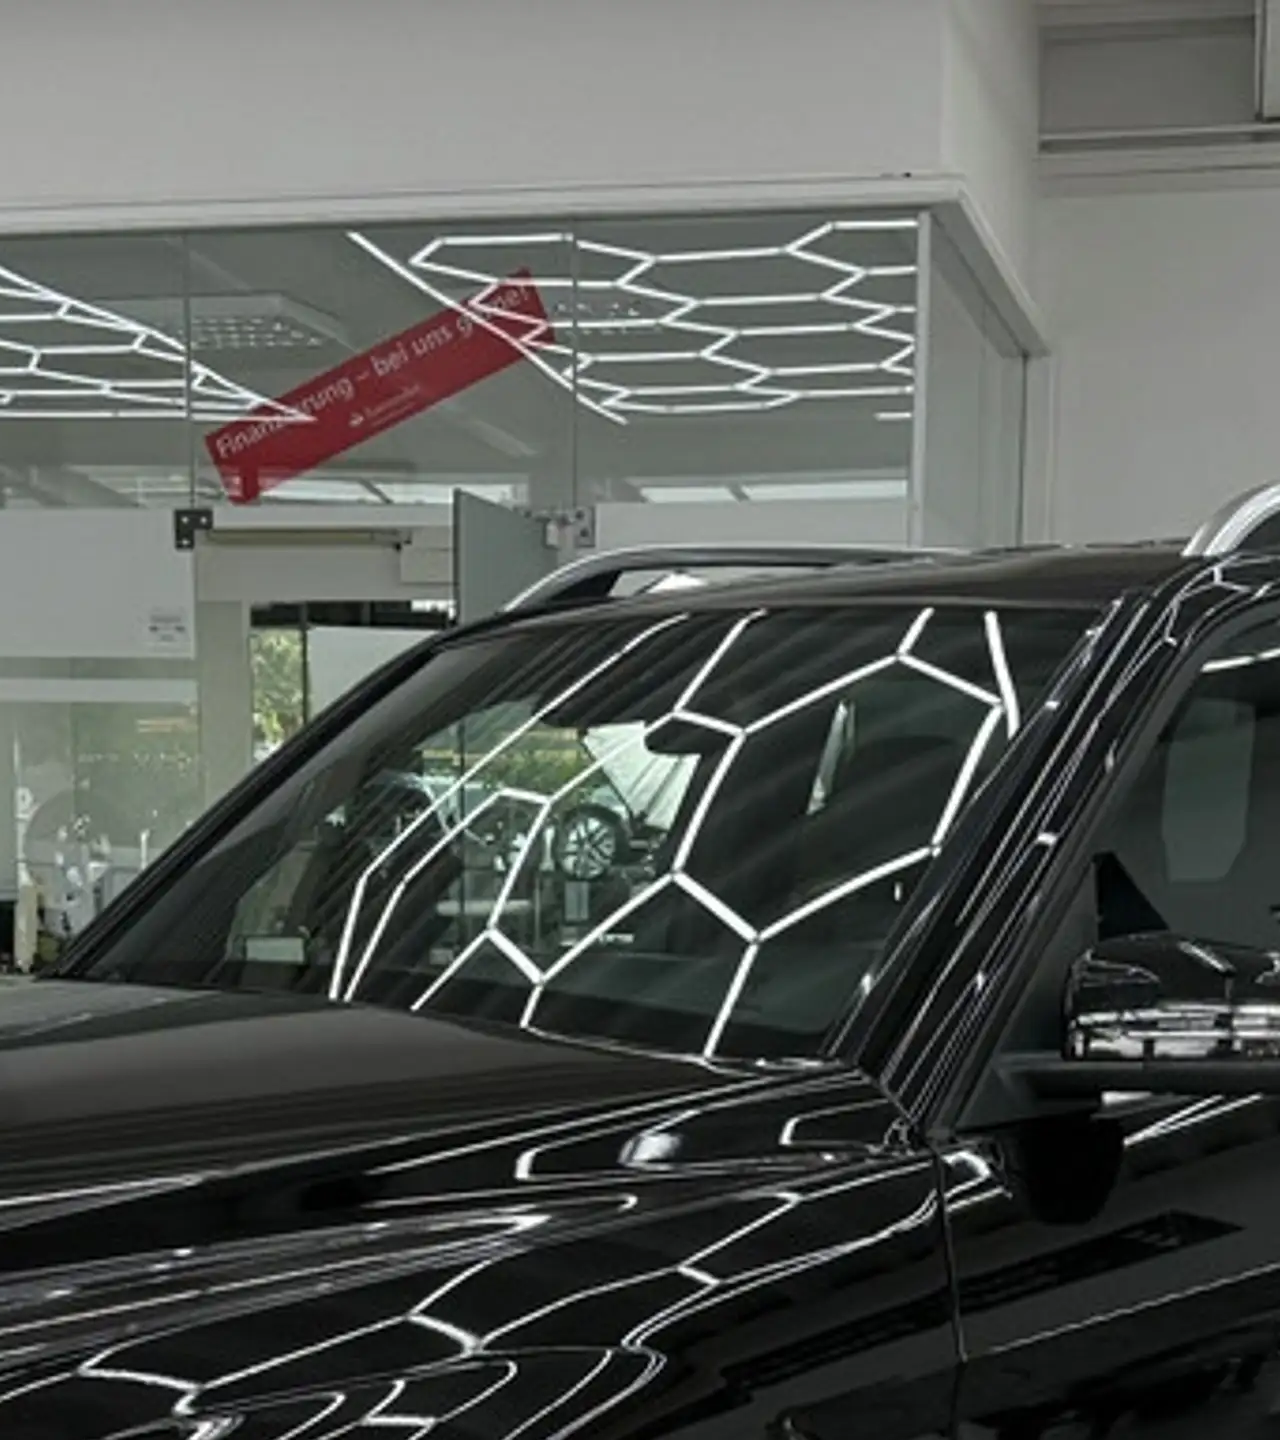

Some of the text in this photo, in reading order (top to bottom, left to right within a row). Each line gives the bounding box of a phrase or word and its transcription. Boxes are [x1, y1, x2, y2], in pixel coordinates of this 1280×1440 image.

[216, 377, 356, 459] Finanzrung
[370, 341, 409, 377] bei
[411, 325, 452, 357] uns
